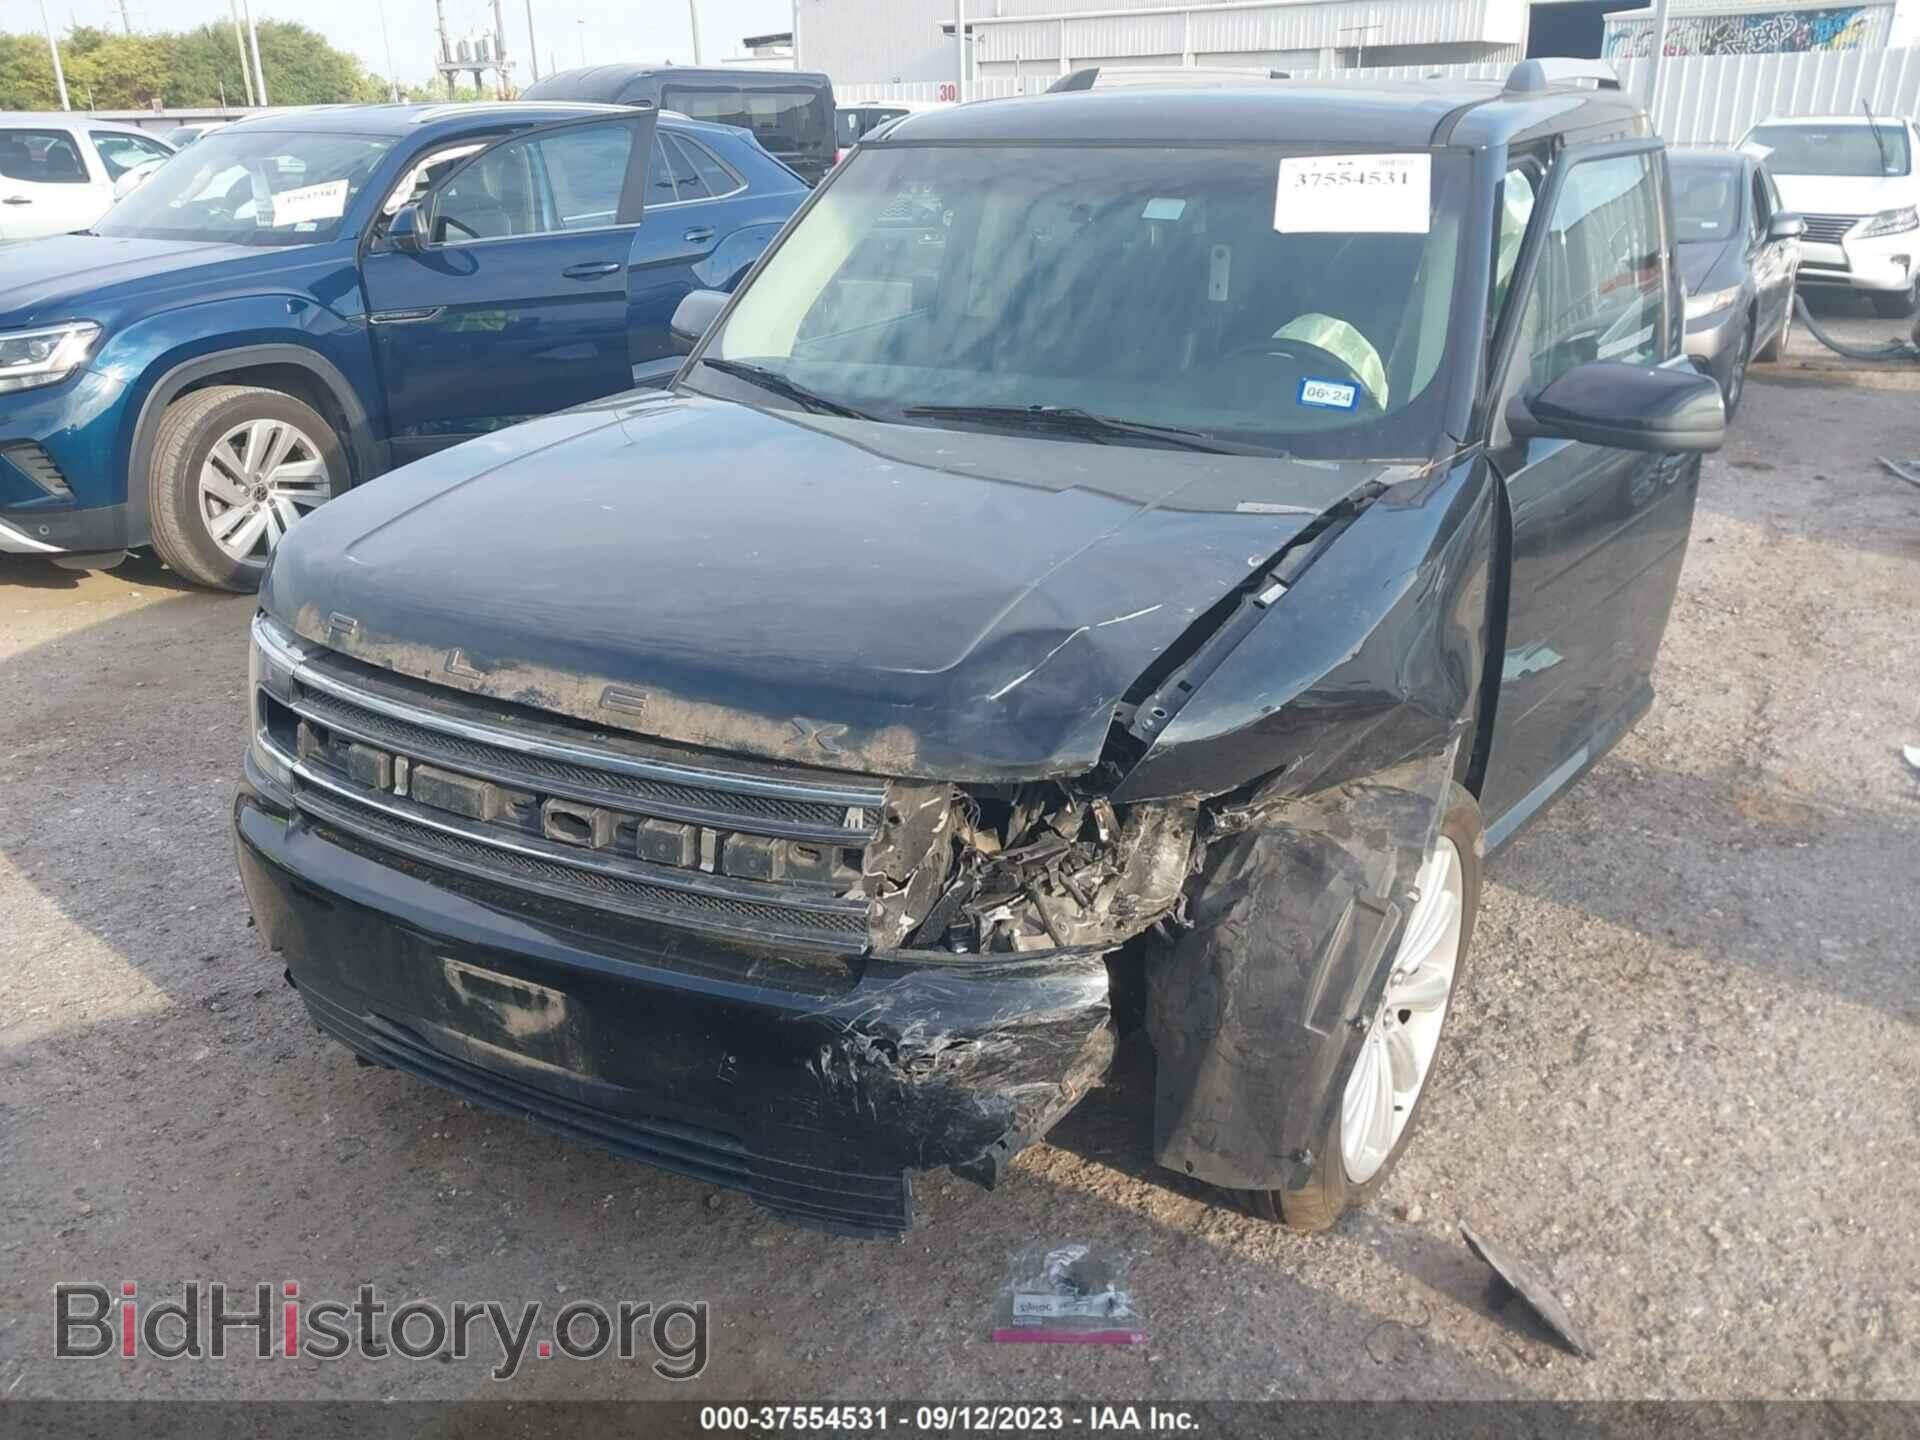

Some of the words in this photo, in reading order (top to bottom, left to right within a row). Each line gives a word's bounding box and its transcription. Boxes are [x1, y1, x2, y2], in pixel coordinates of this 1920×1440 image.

[940, 84, 956, 102] 30
[1294, 171, 1408, 187] 37554531
[328, 610, 849, 755] FLEX
